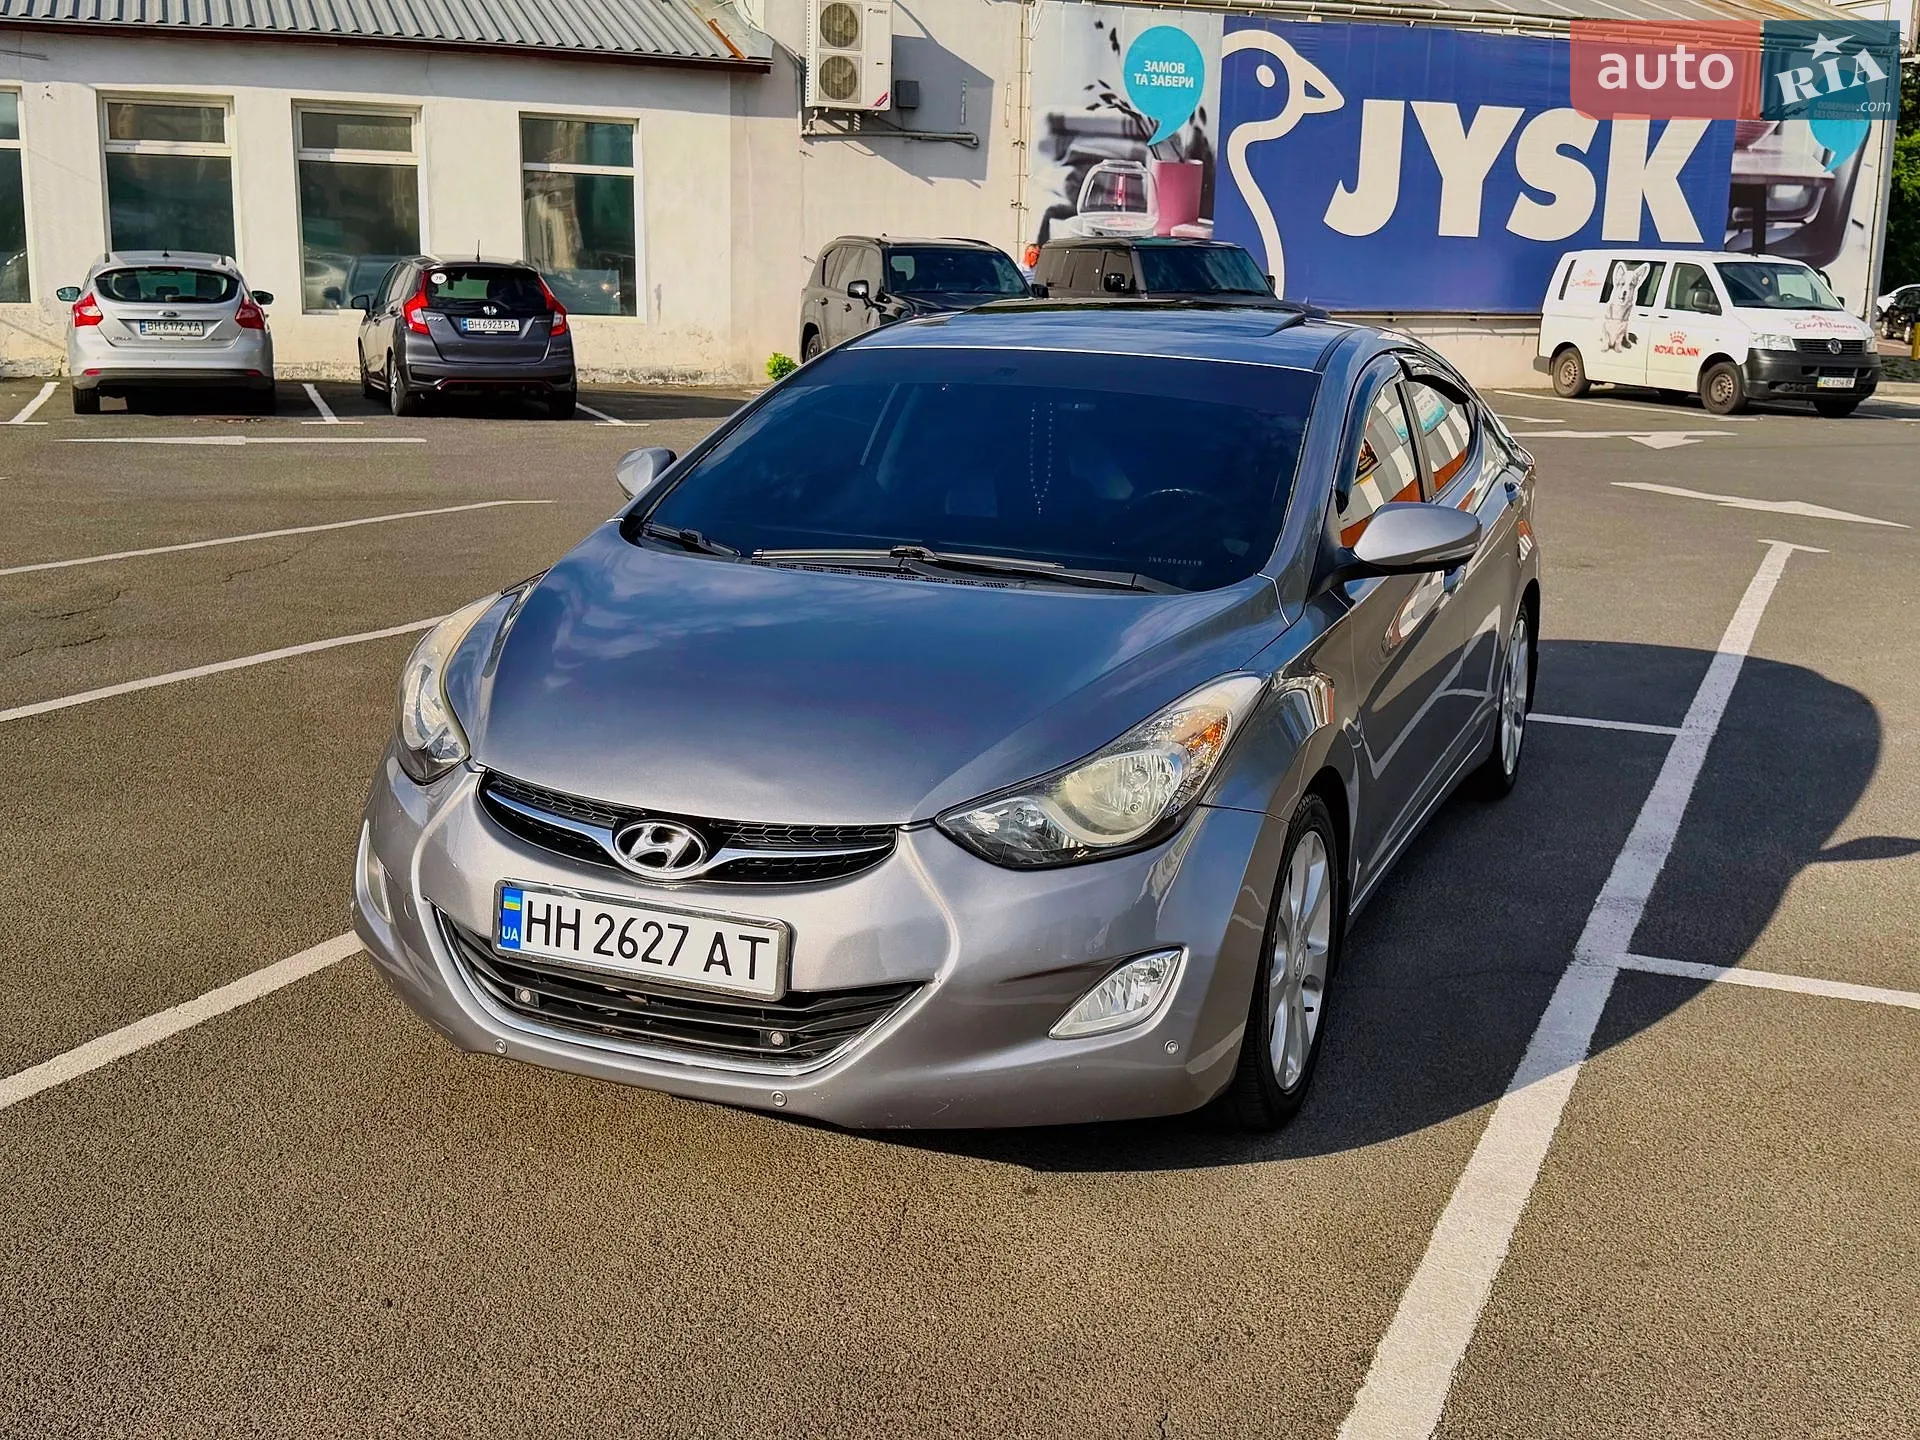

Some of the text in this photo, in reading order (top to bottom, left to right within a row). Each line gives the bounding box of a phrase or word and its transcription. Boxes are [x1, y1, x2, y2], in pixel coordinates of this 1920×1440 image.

[1143, 60, 1185, 74] ЗАМОВ
[1134, 73, 1194, 89] ТА ЗАБЕРИ
[1323, 99, 1715, 243] JYSK
[468, 319, 482, 329] BH
[502, 926, 519, 942] UA
[526, 900, 770, 981] HH 2627 AT
